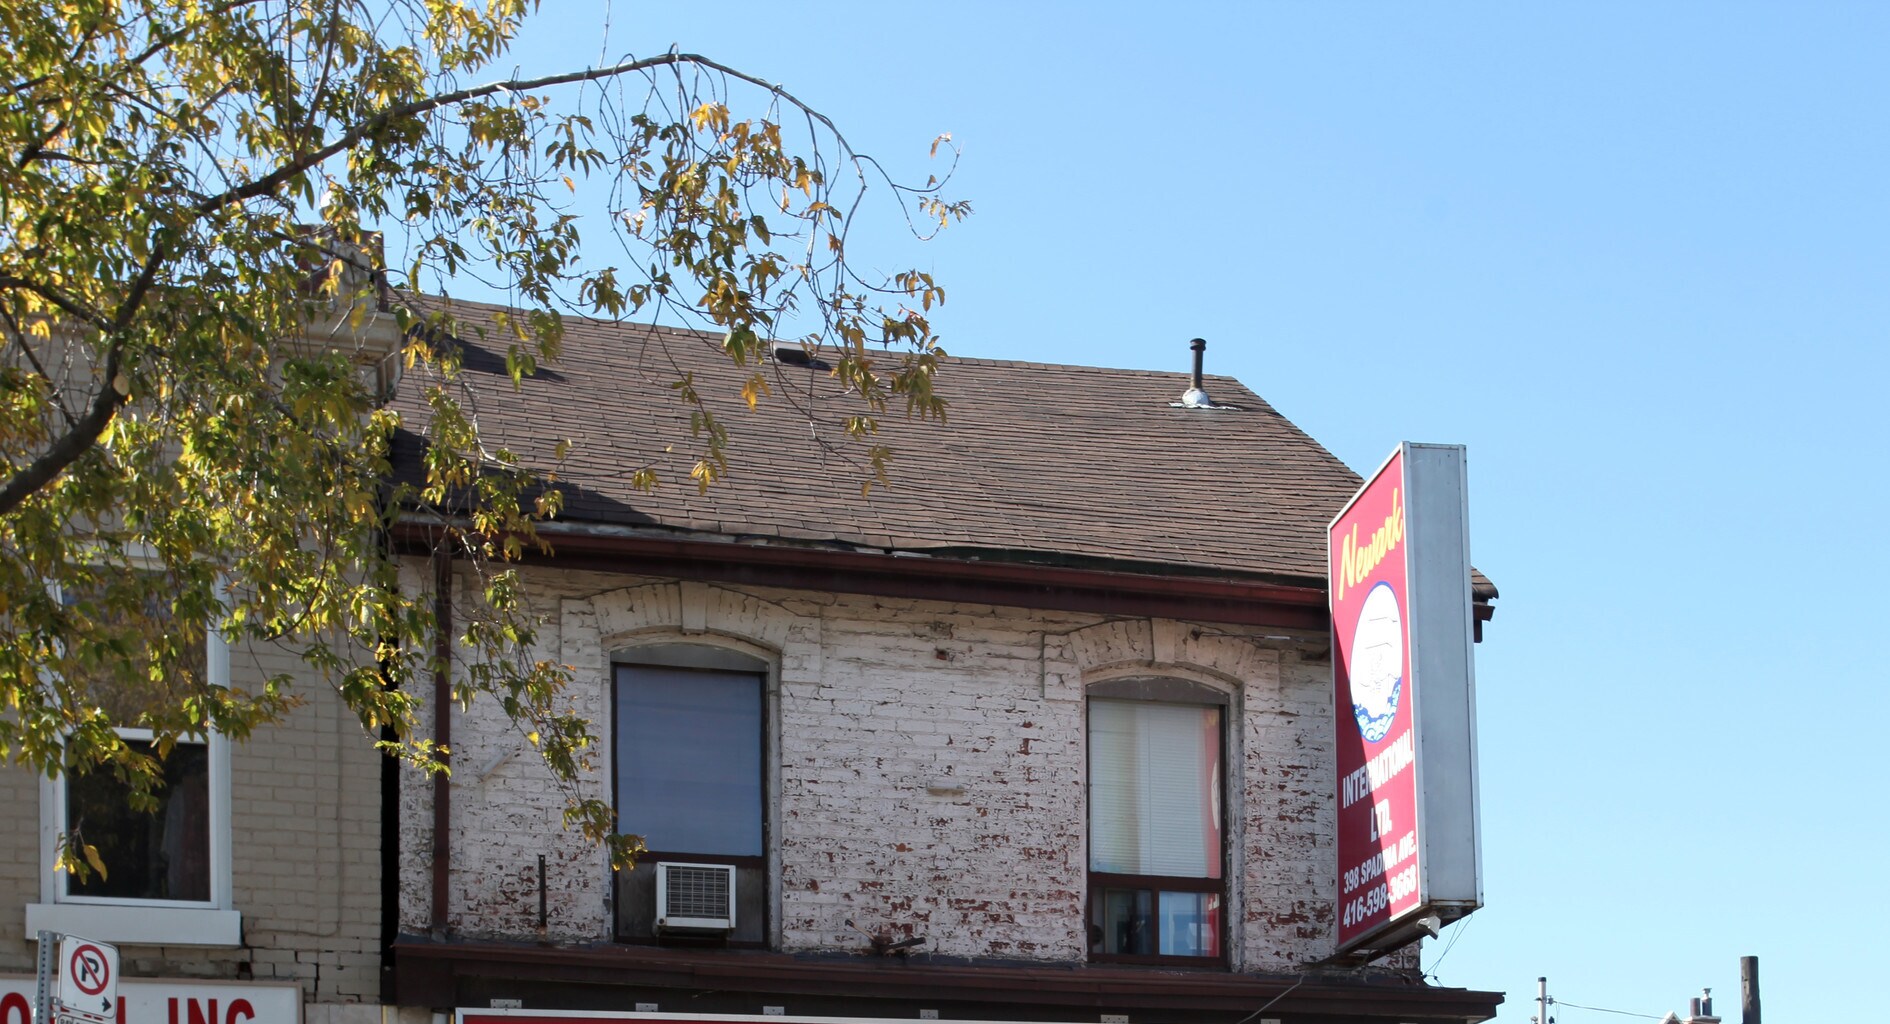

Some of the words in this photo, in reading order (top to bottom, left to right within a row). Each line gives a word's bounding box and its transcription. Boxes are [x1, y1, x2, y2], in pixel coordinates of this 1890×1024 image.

[1339, 488, 1403, 600] Newark
[1343, 732, 1413, 809] INTERNATIONAL
[1371, 799, 1393, 843] LTD.
[1344, 866, 1360, 894] 398
[1361, 843, 1398, 884] SPADINA
[1398, 830, 1417, 863] AVE.
[1343, 864, 1417, 928] 416-598-3668
